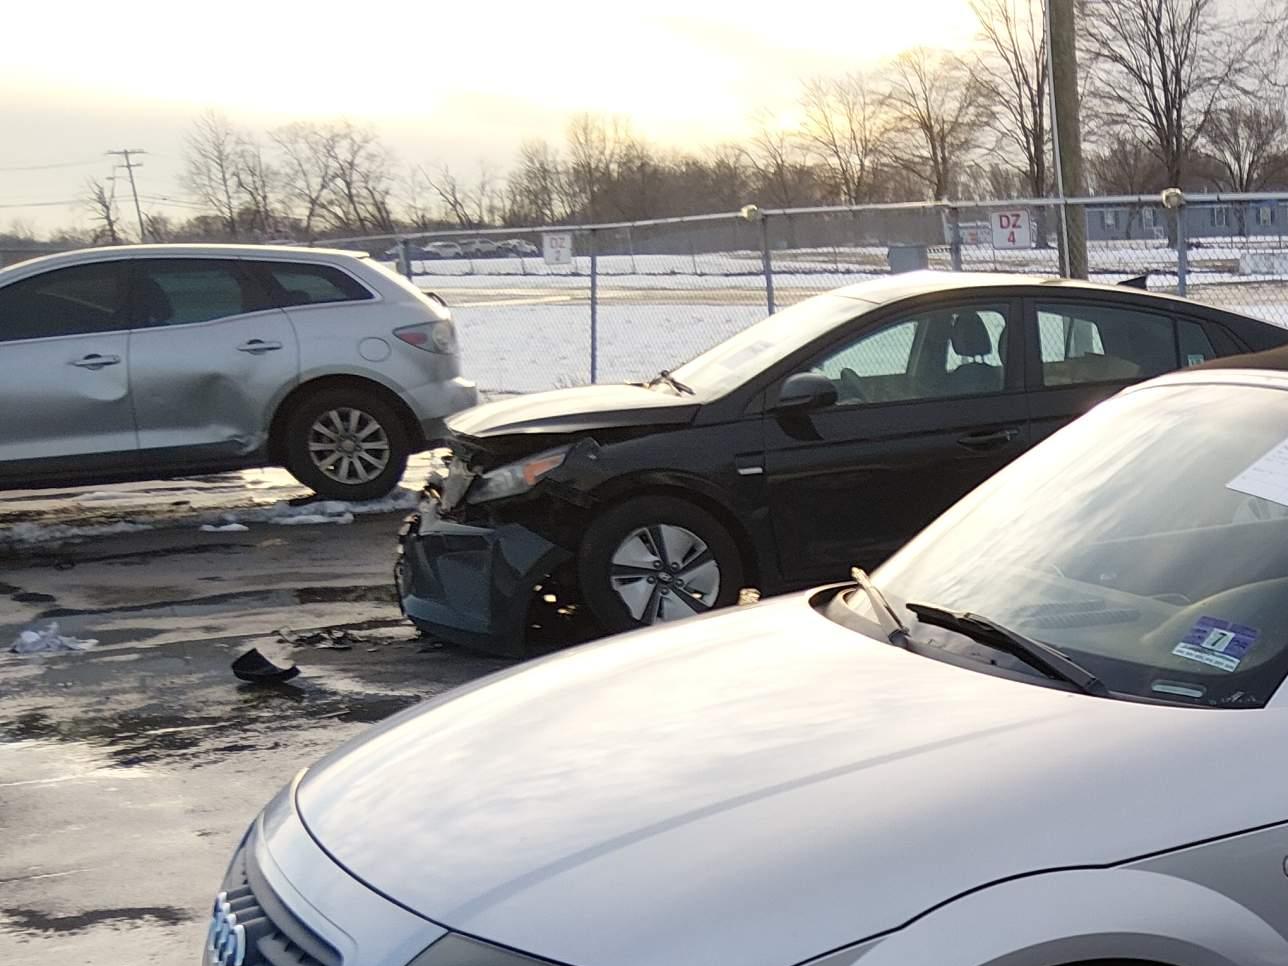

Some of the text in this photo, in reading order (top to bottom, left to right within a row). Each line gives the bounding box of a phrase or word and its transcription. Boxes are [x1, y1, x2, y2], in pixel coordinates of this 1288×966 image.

[999, 213, 1022, 229] DZ
[1007, 231, 1016, 245] 4
[1211, 631, 1228, 647] 7
